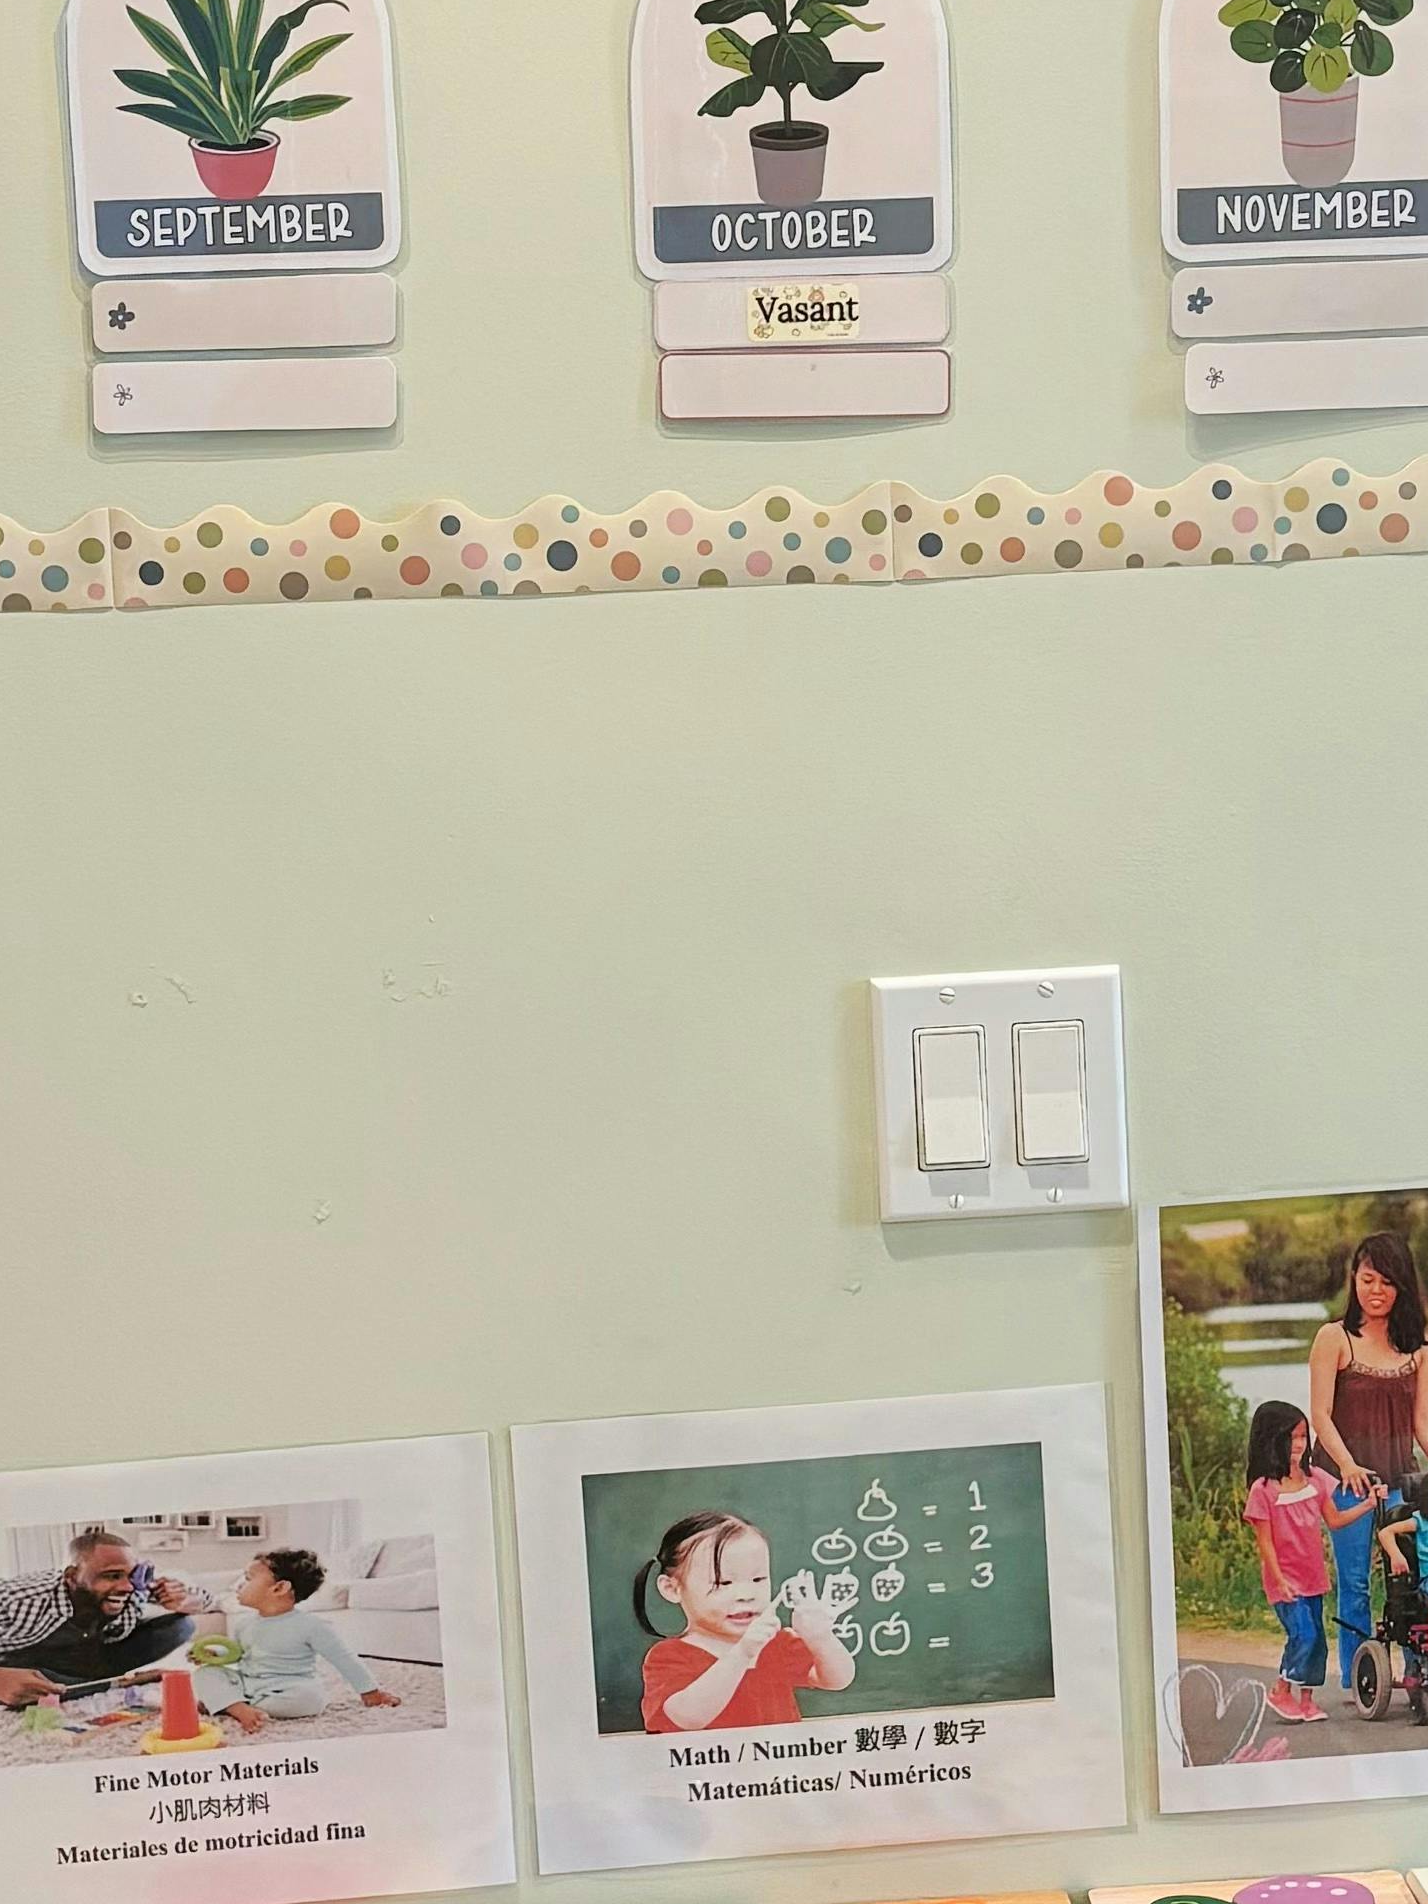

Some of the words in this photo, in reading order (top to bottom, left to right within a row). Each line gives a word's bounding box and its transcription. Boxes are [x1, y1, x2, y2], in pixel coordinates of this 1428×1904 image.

[126, 202, 352, 247] SEPTEMBER
[711, 207, 877, 251] OCTOBER
[1217, 188, 1417, 234] NOVEMBER
[755, 296, 859, 324] Vasant
[969, 1480, 986, 1511] 1
[969, 1525, 992, 1550] 2
[971, 1562, 994, 1588] 3
[669, 1745, 730, 1768] Math
[737, 1743, 745, 1763] /
[753, 1737, 847, 1761] Number
[855, 1724, 907, 1752] 數學
[915, 1726, 925, 1750] /
[934, 1718, 987, 1747] 數字
[94, 1774, 140, 1793] Fine
[147, 1767, 213, 1789] Motor
[219, 1756, 320, 1782] Materials
[688, 1771, 841, 1802] Matemáticas/
[849, 1763, 972, 1790] Numéricos
[149, 1791, 271, 1824] 小肌肉材料
[57, 1839, 169, 1865] Materiales
[174, 1837, 199, 1854] de
[205, 1824, 319, 1852] motricidad
[326, 1822, 366, 1841] fina
